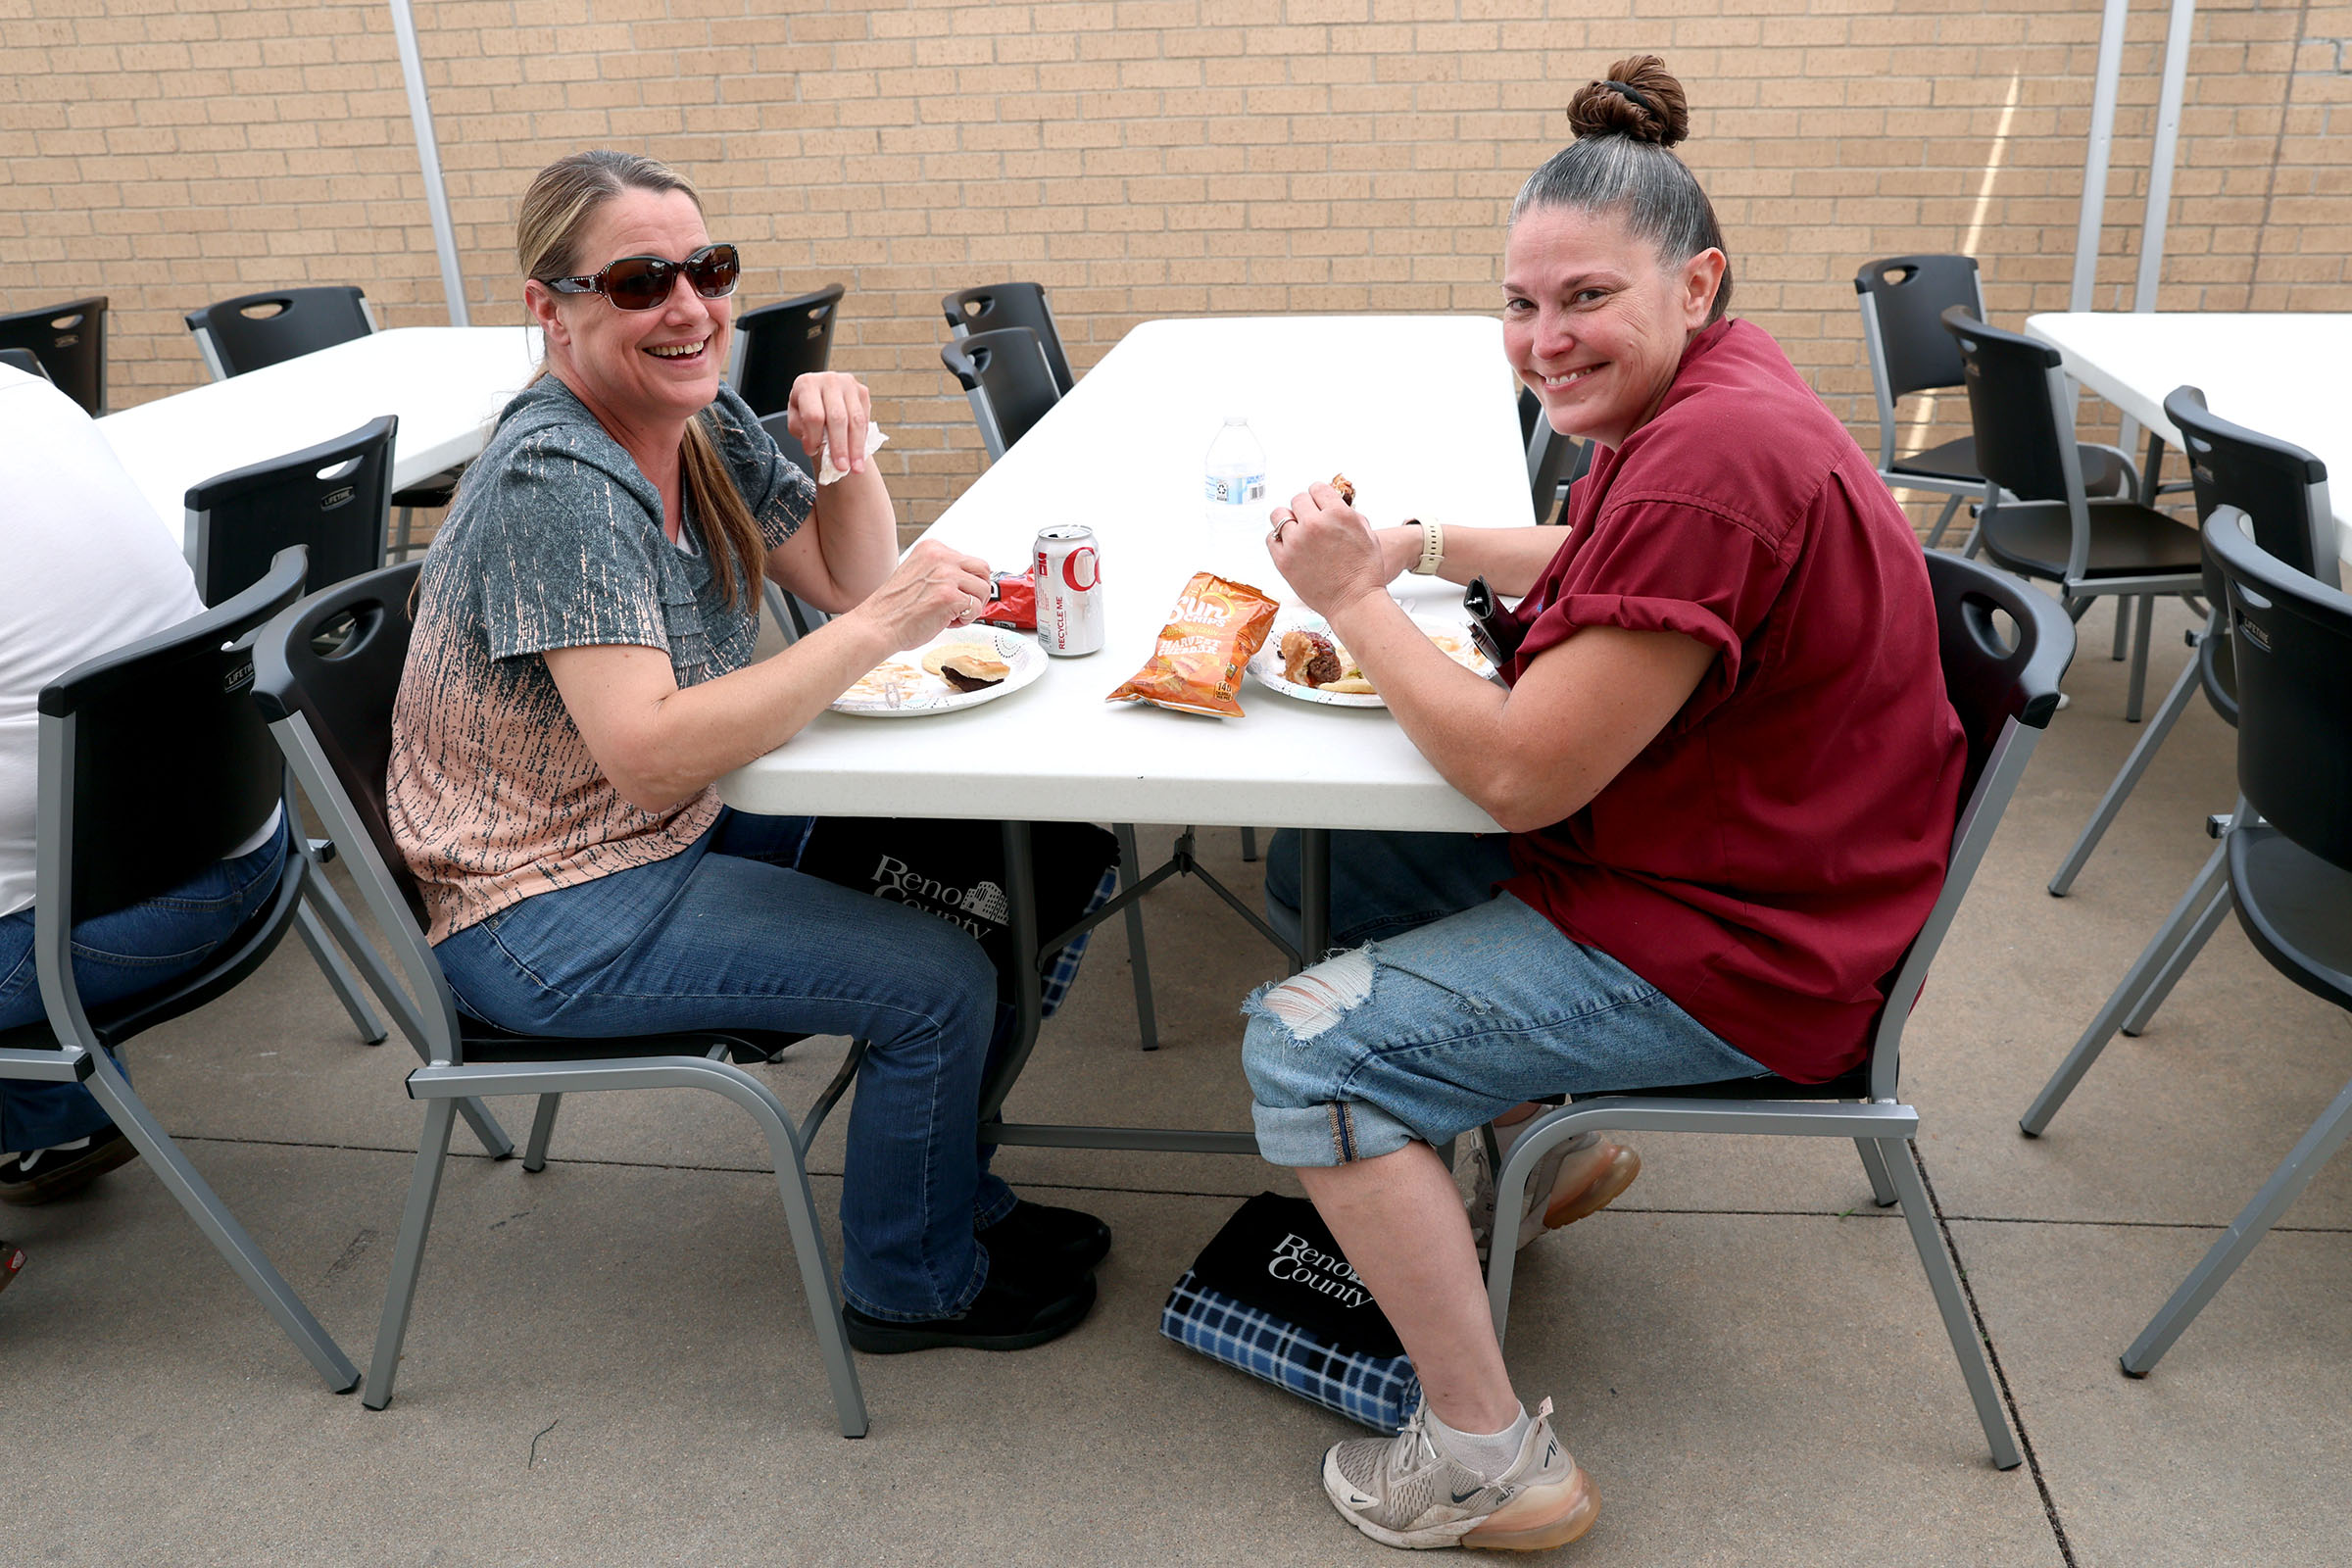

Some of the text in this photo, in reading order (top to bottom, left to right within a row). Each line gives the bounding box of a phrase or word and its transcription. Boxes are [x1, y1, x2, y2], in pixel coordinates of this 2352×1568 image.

[1055, 596, 1065, 650] RECYCLE ME
[1160, 634, 1222, 648] HARVEST
[1183, 614, 1226, 627] CHIPS
[870, 854, 962, 906] Reno
[1272, 1232, 1352, 1277] Reno
[1268, 1255, 1374, 1308] County
